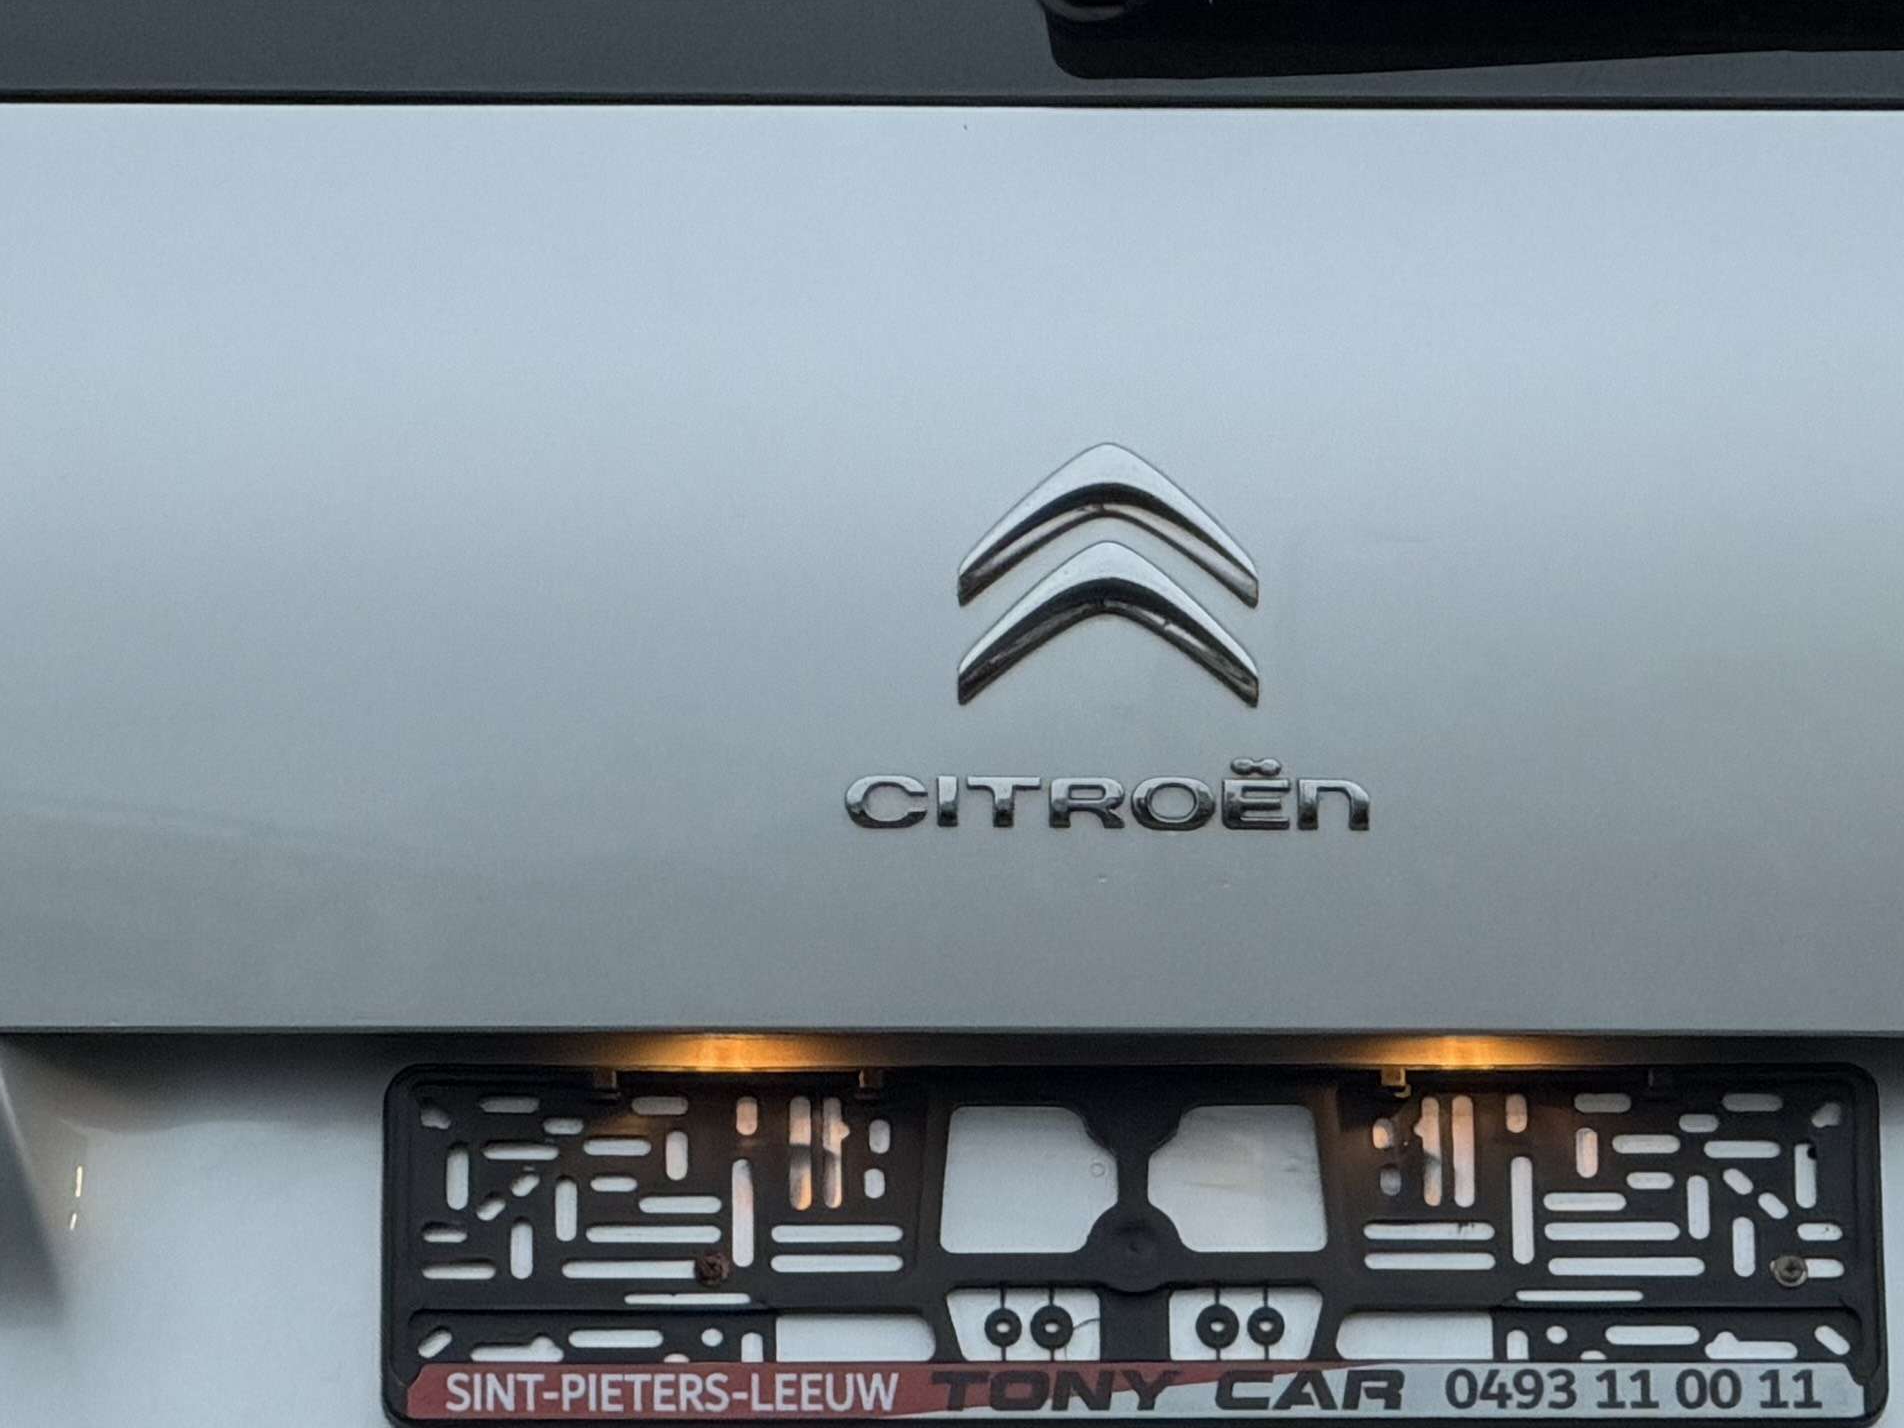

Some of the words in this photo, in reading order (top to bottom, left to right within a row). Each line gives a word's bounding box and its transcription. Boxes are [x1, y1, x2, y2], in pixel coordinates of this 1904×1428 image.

[444, 1371, 900, 1413] SINT-PIETERS-LEEUW
[931, 1368, 1179, 1413] TONY
[1214, 1368, 1405, 1412] CAR
[1444, 1367, 1578, 1410] 0493
[1595, 1368, 1660, 1410] 11
[1675, 1368, 1743, 1410] 00
[1758, 1368, 1824, 1410] 11
